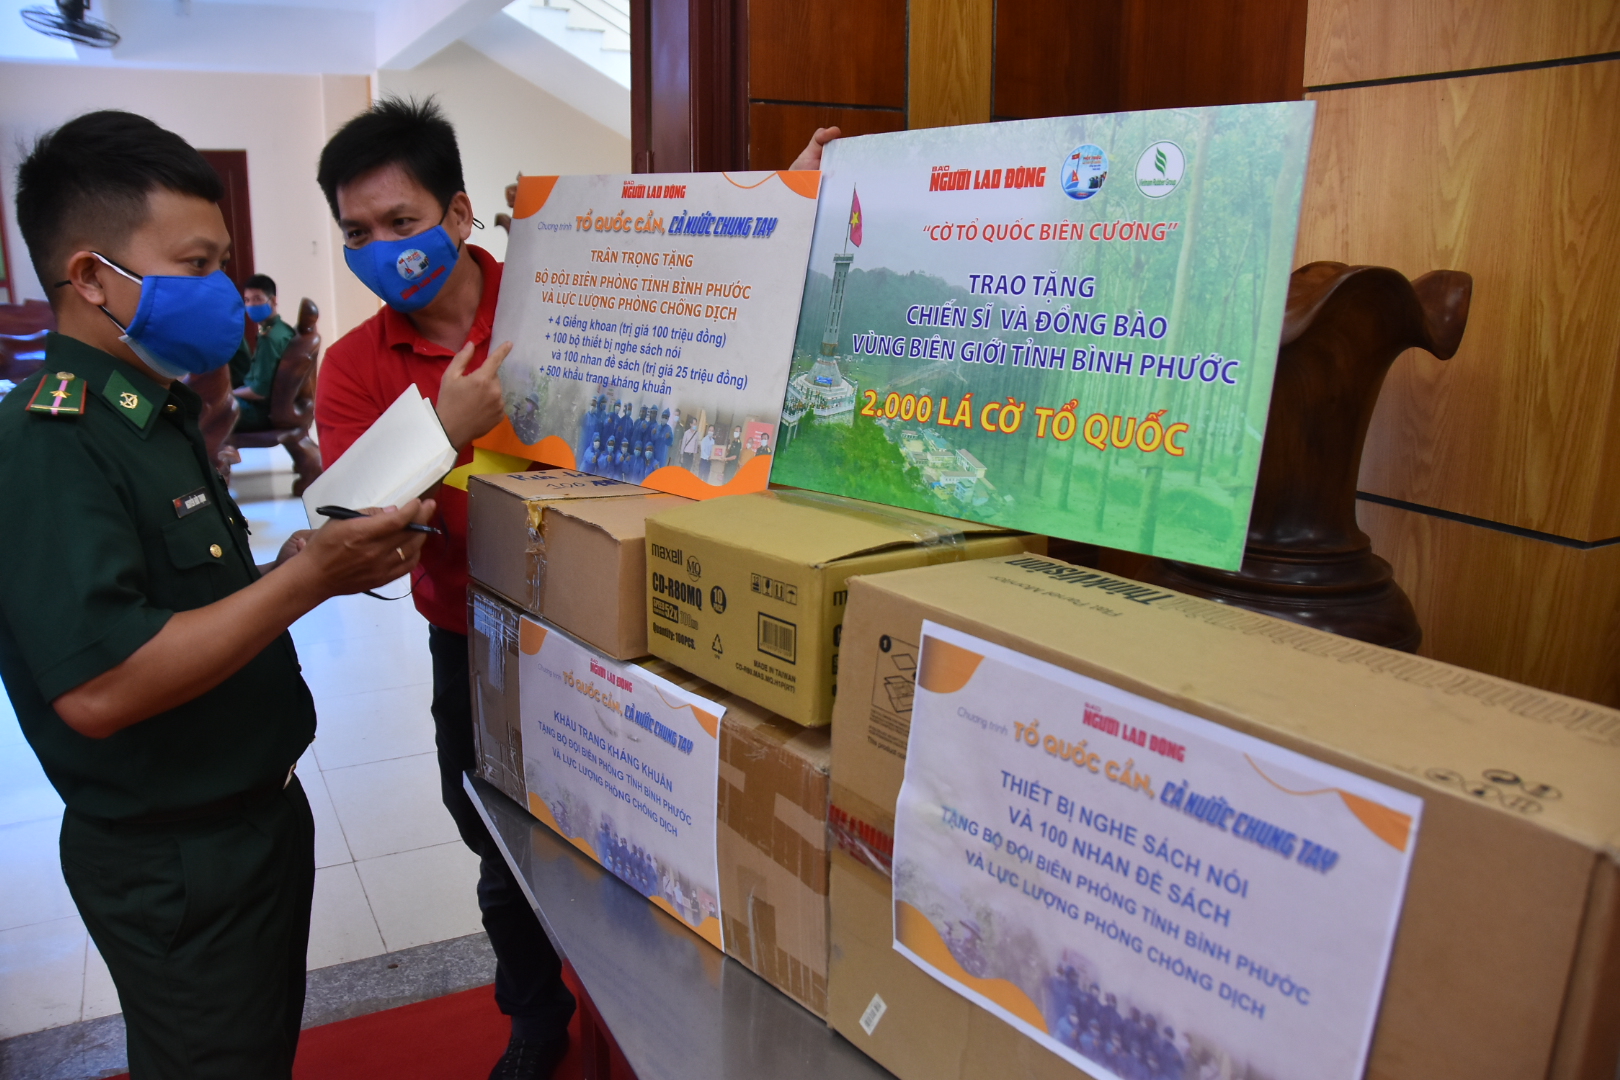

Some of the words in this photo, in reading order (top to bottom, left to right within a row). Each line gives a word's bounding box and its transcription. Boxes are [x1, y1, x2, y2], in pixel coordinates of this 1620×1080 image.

[646, 185, 662, 199] LAO
[663, 184, 687, 199] ĐỘNG
[974, 169, 1001, 190] LAO
[1004, 166, 1046, 190] ĐỘNG
[575, 209, 592, 231] TỔ
[594, 209, 632, 232] QUỐC
[667, 209, 688, 235] CẢ
[683, 211, 716, 236] NƯỚC
[713, 215, 753, 237] CHUNG
[752, 216, 778, 237] TAY
[956, 217, 980, 241] TỔ
[982, 217, 1035, 243] QUỐC
[1038, 219, 1085, 242] BIÊN
[590, 247, 618, 264] TRÂN
[621, 250, 659, 268] TRỌNG
[662, 250, 694, 268] TẶNG
[534, 268, 549, 285] BỘ
[551, 269, 570, 286] ĐỘI
[572, 271, 598, 287] BIÊN
[599, 272, 638, 291] PHÒNG
[641, 274, 669, 293] TỈNH
[671, 276, 703, 296] BÌNH
[705, 280, 752, 300] PHƯỚC
[968, 273, 1027, 296] TRAO
[1032, 270, 1096, 304] TẶNG
[541, 288, 554, 303] VÀ
[556, 291, 575, 307] LỰC
[578, 292, 615, 311] LƯỢNG
[617, 295, 658, 313] PHÒNG
[660, 297, 701, 318] CHỐNG
[705, 304, 738, 322] DỊCH
[906, 299, 968, 328] CHIẾN
[971, 302, 994, 329] SĨ
[1001, 304, 1029, 332] VÀ
[1034, 304, 1108, 336] ĐỒNG
[1112, 309, 1168, 340] BÀO
[552, 332, 568, 345] 100
[569, 333, 580, 347] bộ
[582, 334, 601, 349] thiết
[603, 338, 613, 352] bị
[614, 341, 637, 355] nghe
[639, 342, 663, 357] sách
[665, 347, 682, 359] nói
[555, 315, 561, 326] 4
[562, 314, 588, 332] Giếng
[589, 318, 617, 333] khoan
[619, 322, 633, 337] (trị
[634, 322, 649, 339] giá
[652, 325, 669, 339] 100
[671, 327, 693, 343] triệu
[696, 328, 727, 349] đồng)
[551, 349, 561, 361] và
[563, 350, 578, 363] 100
[580, 352, 602, 367] nhan
[604, 353, 616, 369] đề
[617, 356, 640, 373] sách
[642, 361, 657, 377] (trị
[658, 362, 674, 379] giá
[675, 365, 688, 380] 25
[690, 367, 714, 384] triệu
[716, 369, 749, 391] đồng)
[852, 330, 906, 358] VÙNG
[908, 334, 957, 361] BIÊN
[960, 337, 1008, 366] GIỚI
[1011, 338, 1067, 370] TỈNH
[1071, 344, 1134, 375] BÌNH
[1139, 352, 1239, 385] PHƯỚC
[545, 364, 561, 378] 500
[562, 365, 584, 382] khẩu
[585, 370, 609, 388] trang
[611, 373, 640, 393] kháng
[641, 378, 672, 396] khuẩn
[861, 389, 933, 424] 2.000
[936, 392, 974, 428] LÁ
[979, 396, 1026, 434] CỜ
[1034, 398, 1079, 442] TỔ
[1083, 409, 1190, 457] QUỐC
[651, 542, 683, 566] maxell
[652, 571, 703, 612] CD-R80MQ
[1004, 557, 1175, 606] ThinkVision
[753, 660, 768, 672] MADE
[769, 665, 775, 675] IN
[775, 668, 796, 683] TAIWAN
[578, 724, 606, 750] TRANG
[607, 742, 640, 770] KHÁNG
[653, 720, 679, 748] CHUNG
[598, 757, 625, 781] PHÒNG
[663, 799, 692, 826] PHƯỚC
[604, 780, 631, 804] PHÒNG
[659, 816, 678, 838] DỊCH
[1013, 718, 1040, 747] TỔ
[1043, 738, 1101, 774] QUỐC
[1159, 779, 1189, 812] CẢ
[1231, 811, 1299, 860] CHUNG
[1297, 838, 1340, 875] TAY
[1056, 794, 1075, 823] BỊ
[1079, 805, 1138, 847] NGHE
[1142, 833, 1201, 878] SÁCH
[1206, 863, 1249, 899] NÓI
[1009, 805, 1034, 832] VÀ
[1040, 820, 1068, 848] 100
[1072, 836, 1131, 878] NHAN
[1167, 882, 1231, 928] SÁCH
[1022, 878, 1079, 920] LƯỢNG
[1084, 910, 1144, 955] PHÒNG
[1218, 981, 1266, 1020] DỊCH
[1076, 873, 1138, 916] PHÒNG
[1235, 953, 1311, 1007] PHƯỚC
